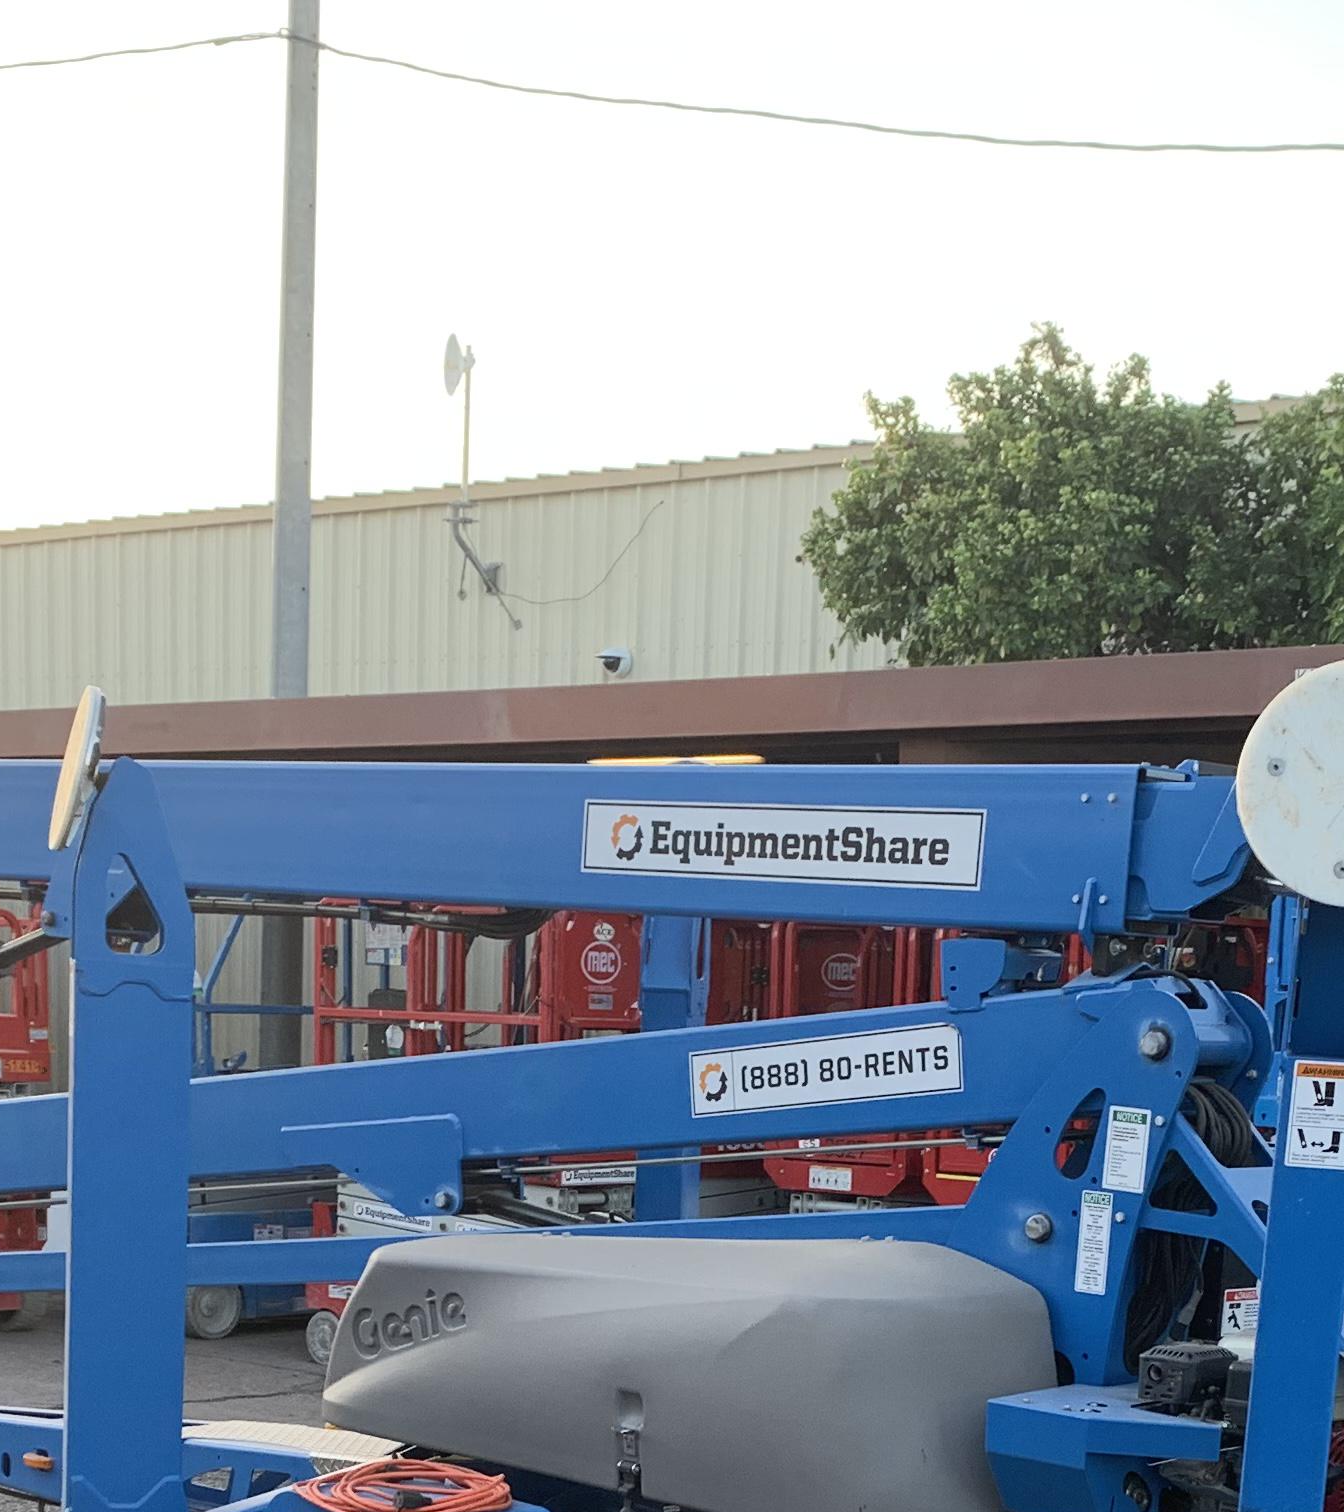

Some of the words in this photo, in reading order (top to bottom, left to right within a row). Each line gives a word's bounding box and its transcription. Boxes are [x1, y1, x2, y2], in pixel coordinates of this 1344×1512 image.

[649, 820, 951, 866] EquipmentShare
[741, 1059, 809, 1093] (888)
[819, 1045, 950, 1083] 80-RENTS
[1116, 1111, 1144, 1124] NOTICE
[352, 1288, 467, 1360] Genie
